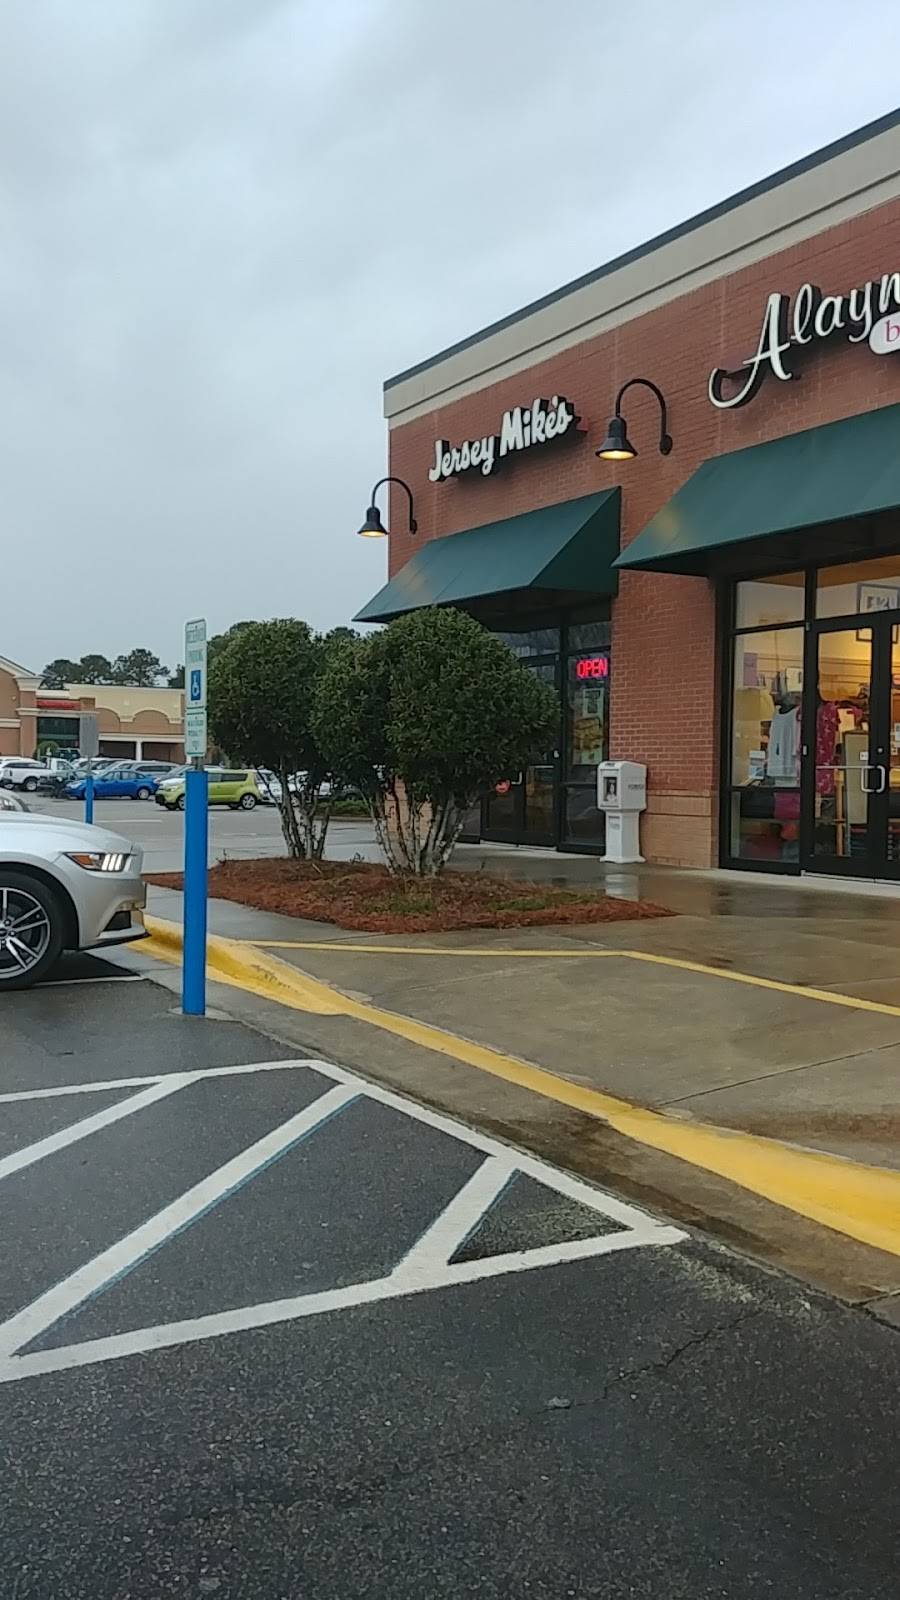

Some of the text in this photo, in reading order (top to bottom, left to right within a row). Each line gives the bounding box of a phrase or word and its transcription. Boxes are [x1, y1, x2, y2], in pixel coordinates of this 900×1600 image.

[428, 395, 573, 482] Jersey Mike's
[576, 658, 608, 678] OPEN
